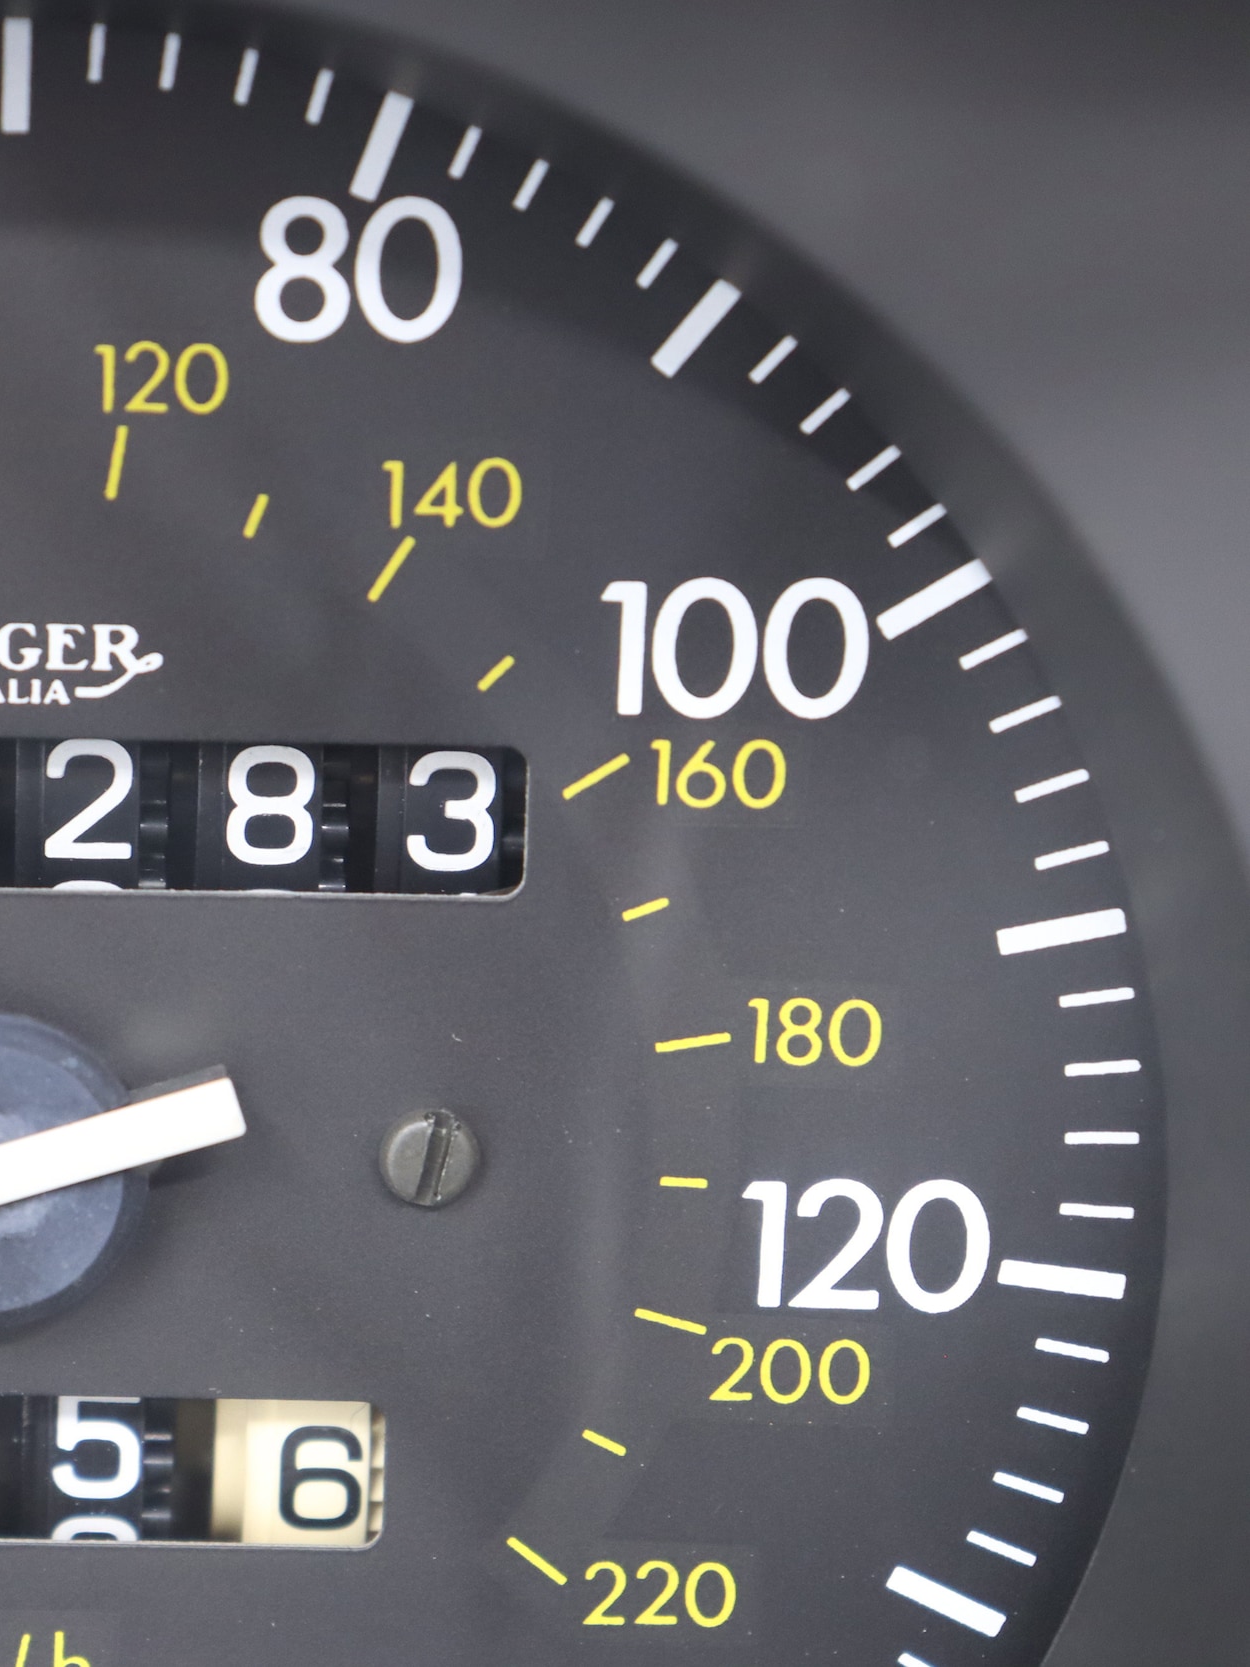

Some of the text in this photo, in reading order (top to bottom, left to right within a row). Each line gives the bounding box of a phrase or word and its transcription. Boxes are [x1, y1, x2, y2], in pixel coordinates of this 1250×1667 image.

[253, 196, 463, 344] 80
[93, 340, 231, 416] 120
[381, 457, 524, 529] 140
[600, 576, 870, 721] 100
[650, 738, 788, 810] 160
[747, 996, 883, 1068] 180
[741, 1176, 991, 1315] 120
[708, 1336, 872, 1406] 200
[582, 1559, 738, 1629] 220
